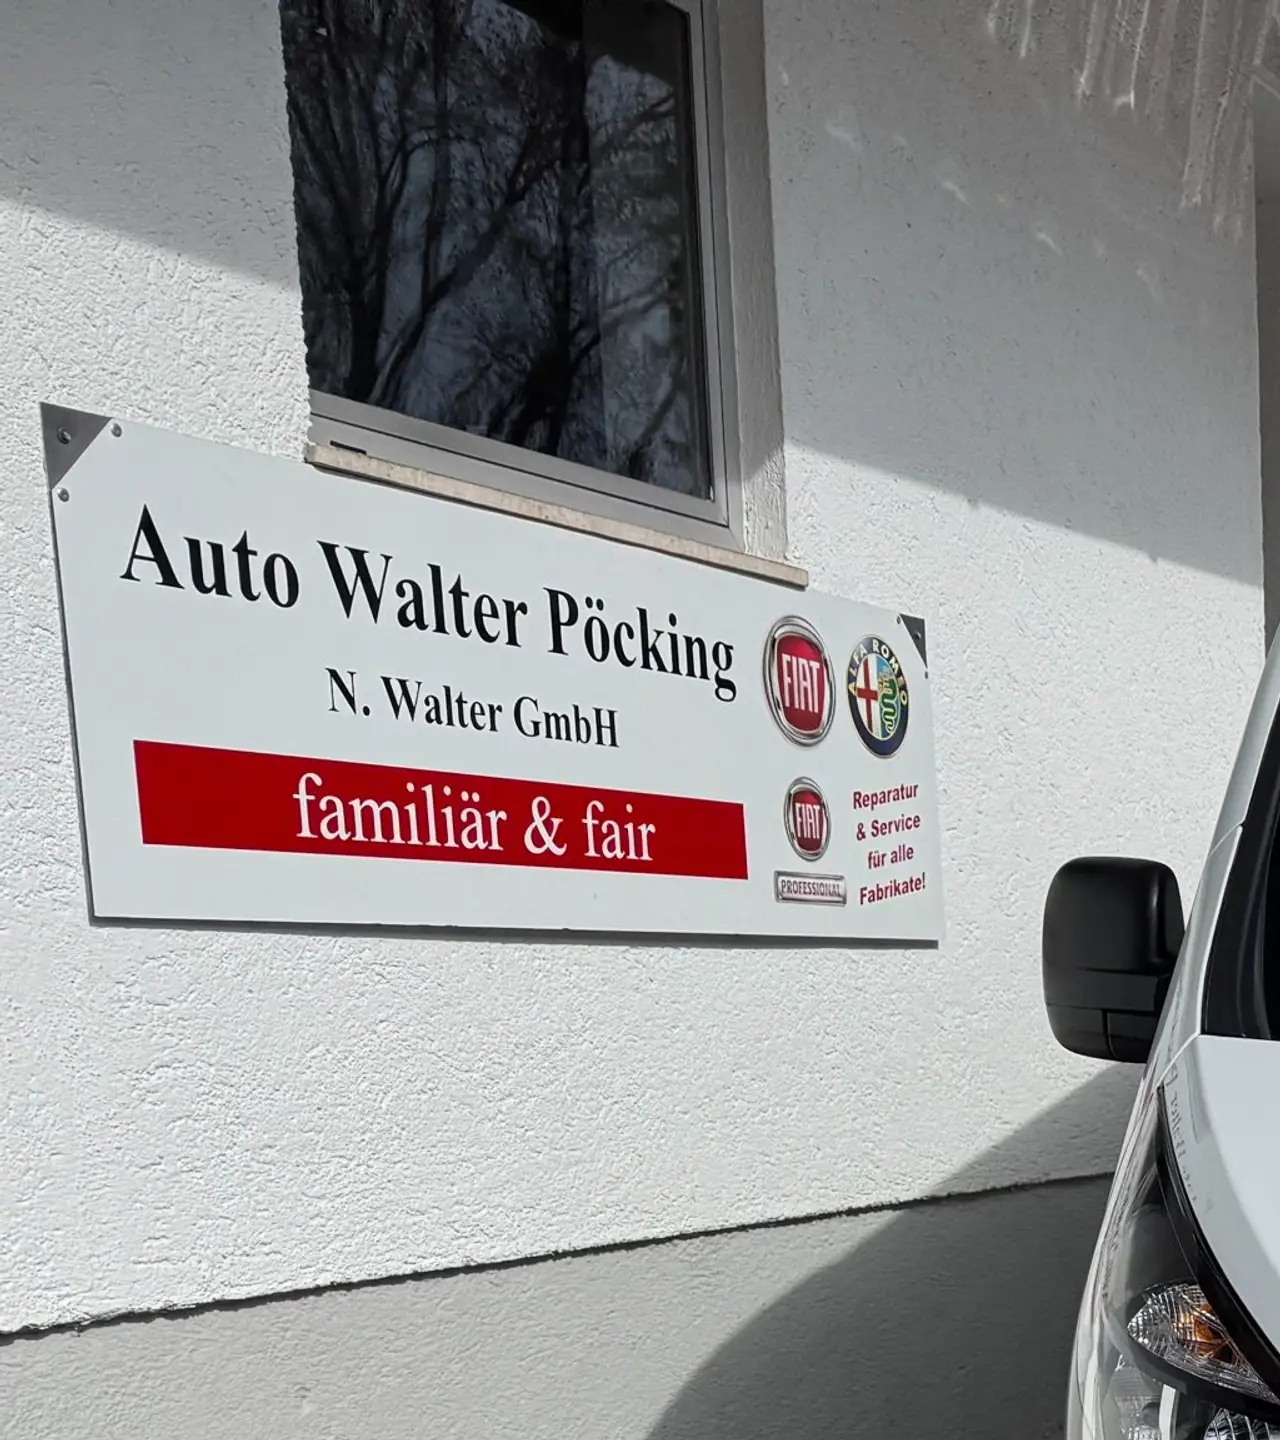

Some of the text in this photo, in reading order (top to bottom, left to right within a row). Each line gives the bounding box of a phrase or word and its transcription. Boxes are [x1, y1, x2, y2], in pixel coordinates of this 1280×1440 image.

[119, 503, 738, 703] Auto Walter Pöcking
[781, 653, 821, 714] FIAT
[848, 644, 868, 697] ALFA
[325, 667, 620, 749] N. Walter GmbH
[853, 783, 919, 811] Reparatur
[292, 772, 657, 862] familiär & fair
[794, 802, 822, 840] FIAT
[856, 813, 921, 841] & Service
[867, 843, 915, 870] für alle
[780, 879, 842, 897] PROFESSIONAL
[859, 871, 926, 906] Fabrikate!
